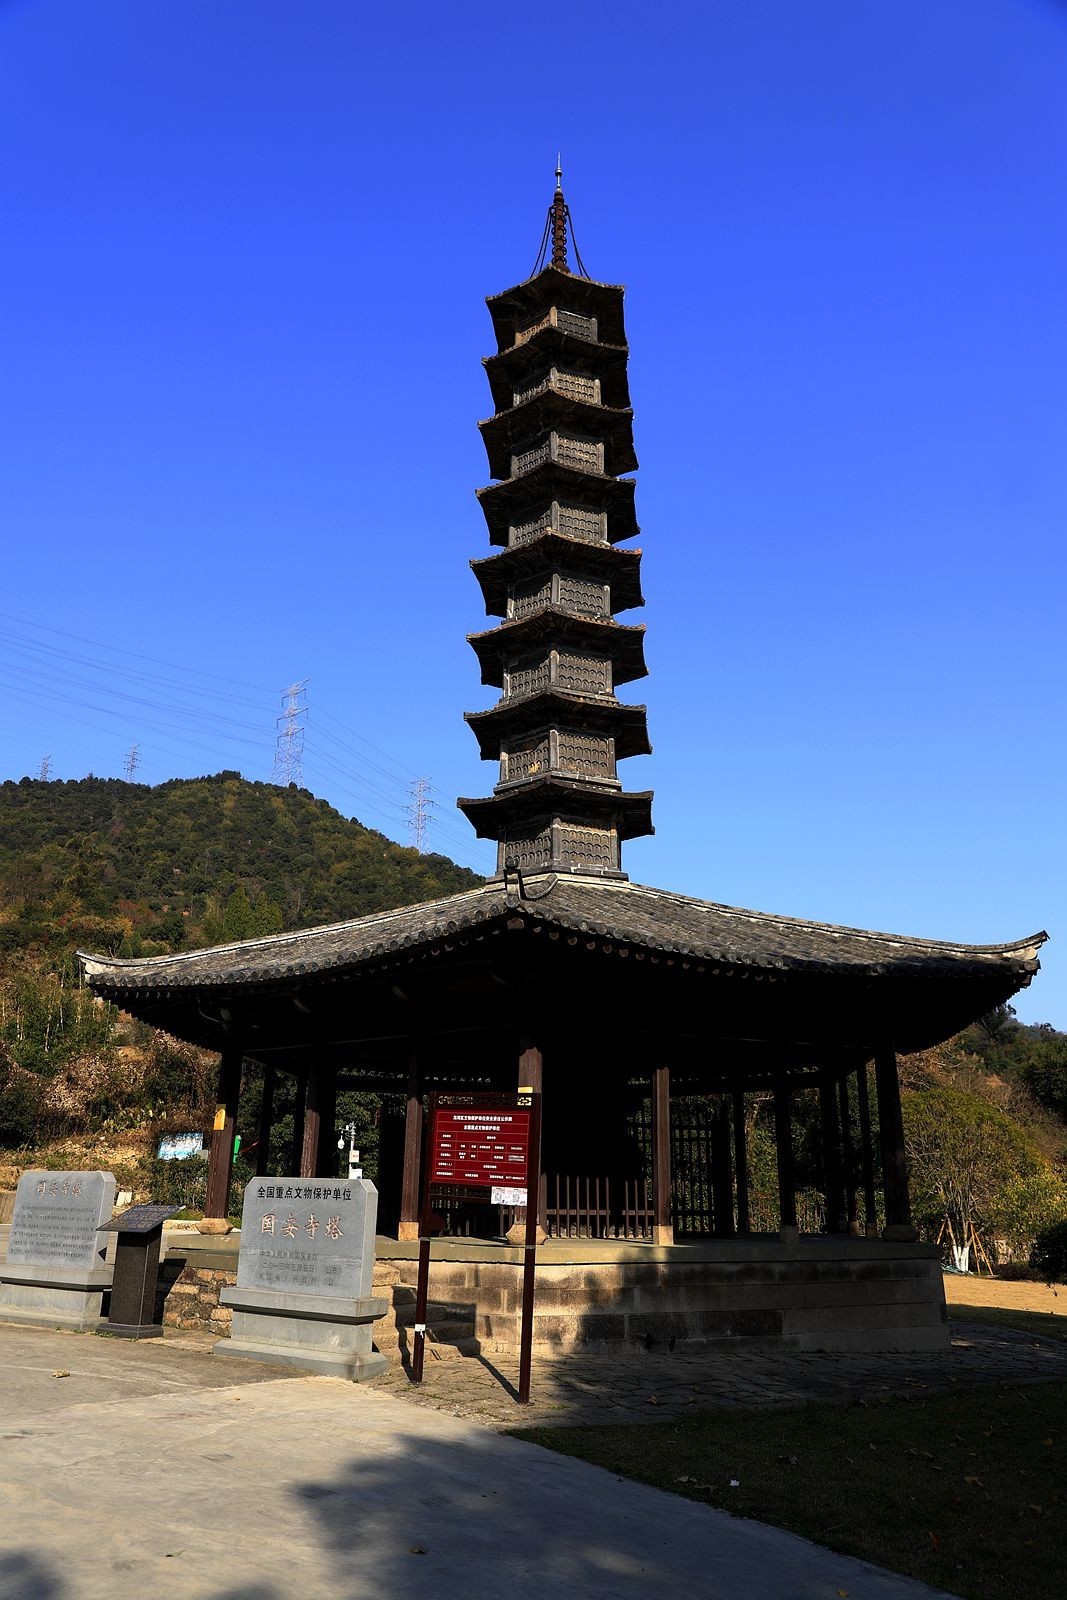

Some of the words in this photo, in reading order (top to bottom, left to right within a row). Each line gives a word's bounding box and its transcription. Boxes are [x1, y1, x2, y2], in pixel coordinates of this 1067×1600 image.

[257, 1186, 352, 1201] 全国重点文物保护单位
[260, 1211, 345, 1240] 国安寺塔
